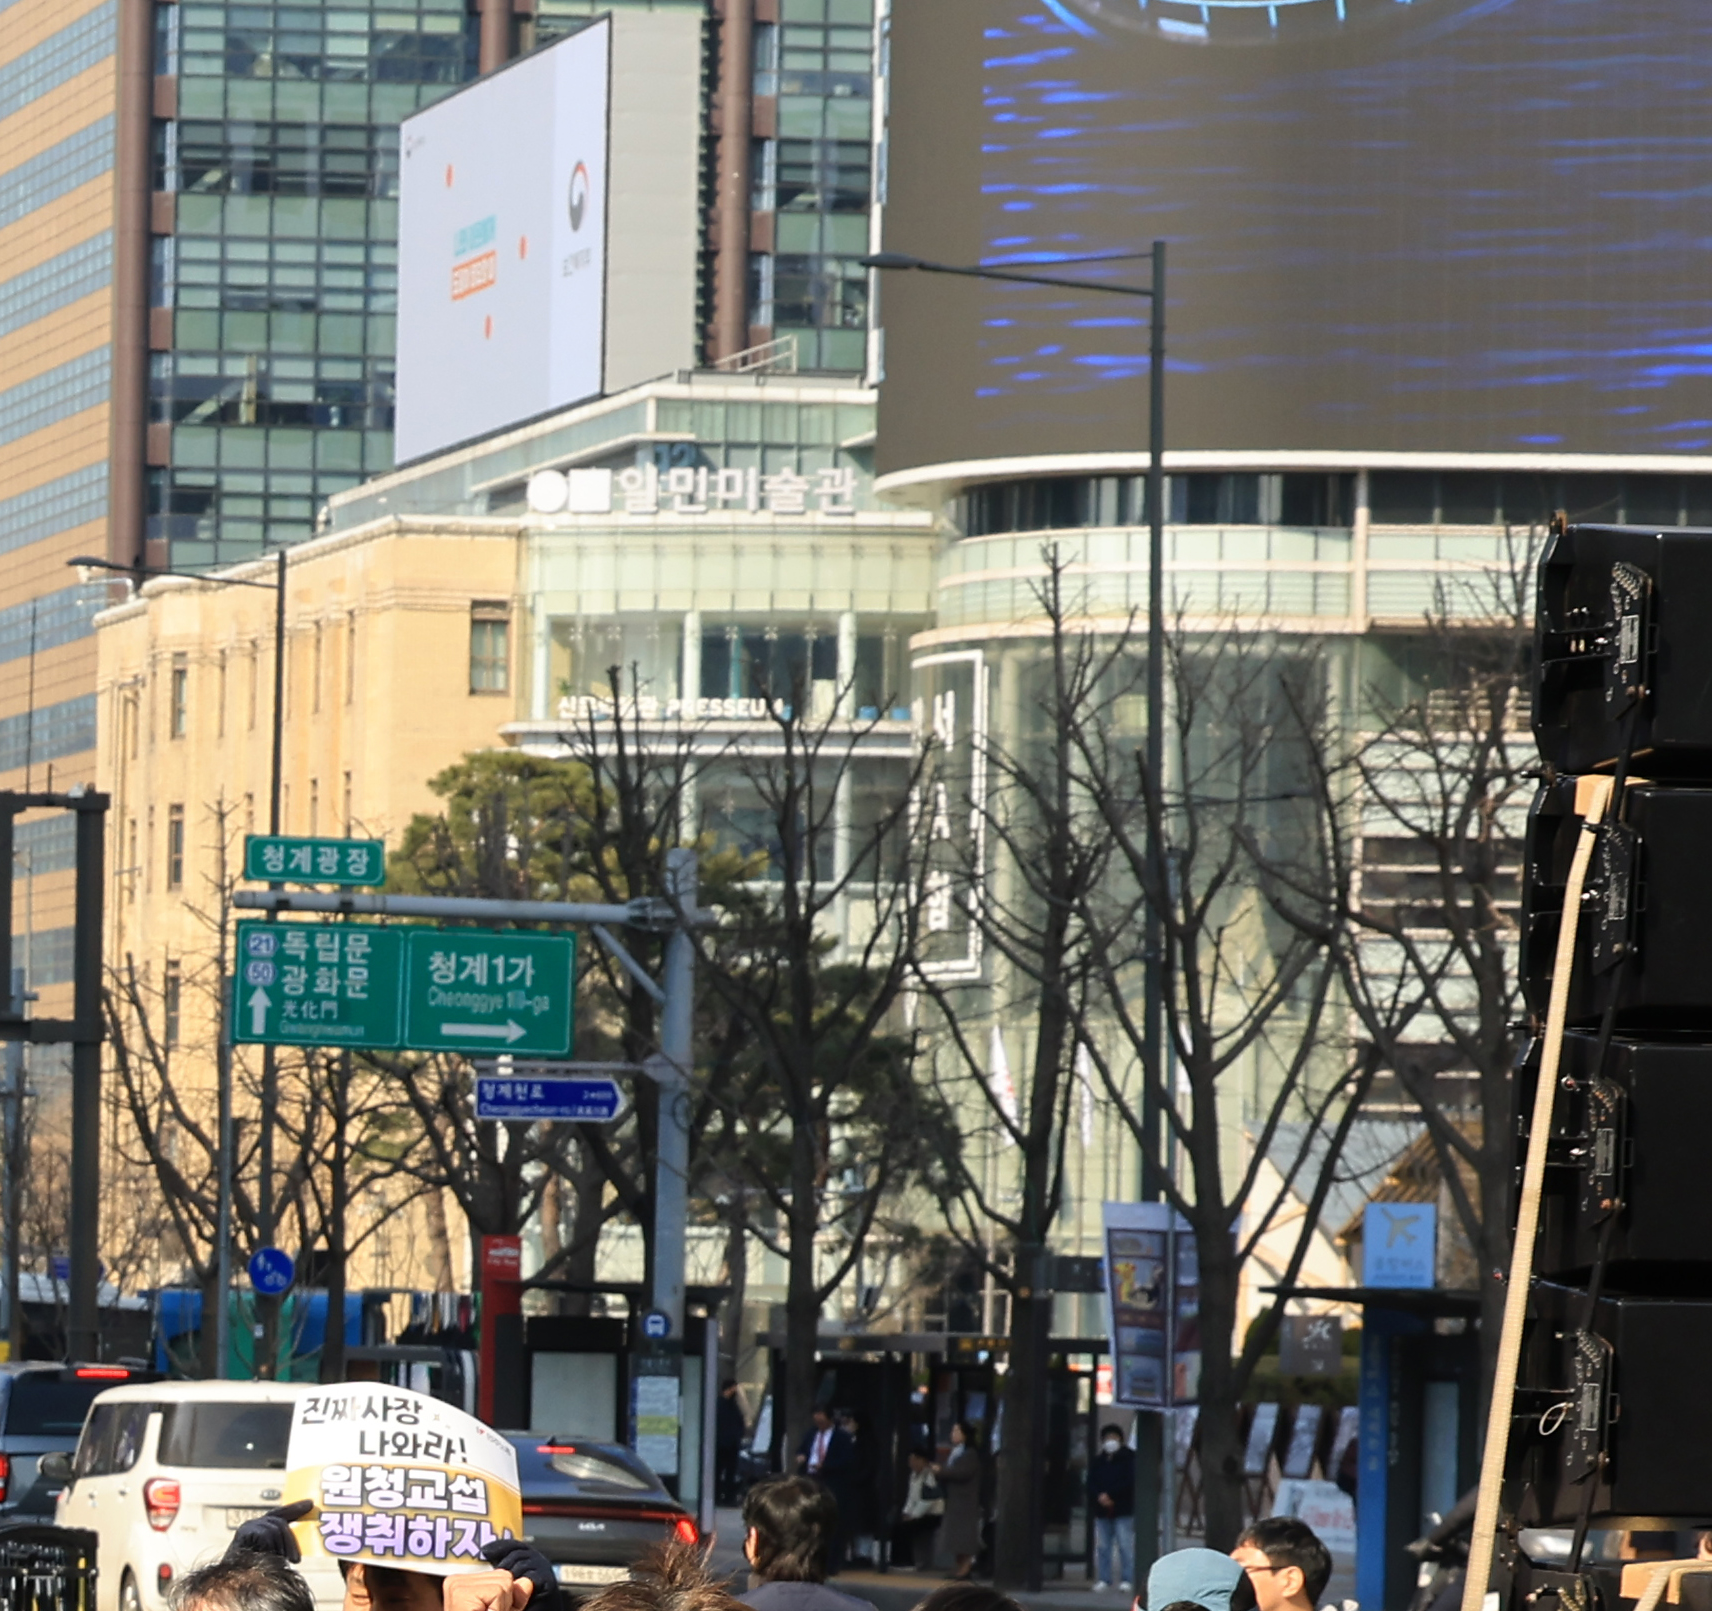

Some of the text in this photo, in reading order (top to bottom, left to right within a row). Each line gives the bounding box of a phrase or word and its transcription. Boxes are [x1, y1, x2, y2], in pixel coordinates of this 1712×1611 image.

[617, 462, 856, 514] 일민미술관
[261, 844, 370, 877] 청계광장
[283, 932, 372, 964] 독립문
[282, 966, 368, 998] 광화문
[429, 953, 535, 988] 청계1가
[300, 1393, 422, 1428] 진짜사장
[359, 1427, 469, 1464] 나와라!
[320, 1466, 491, 1516] 원청교섭
